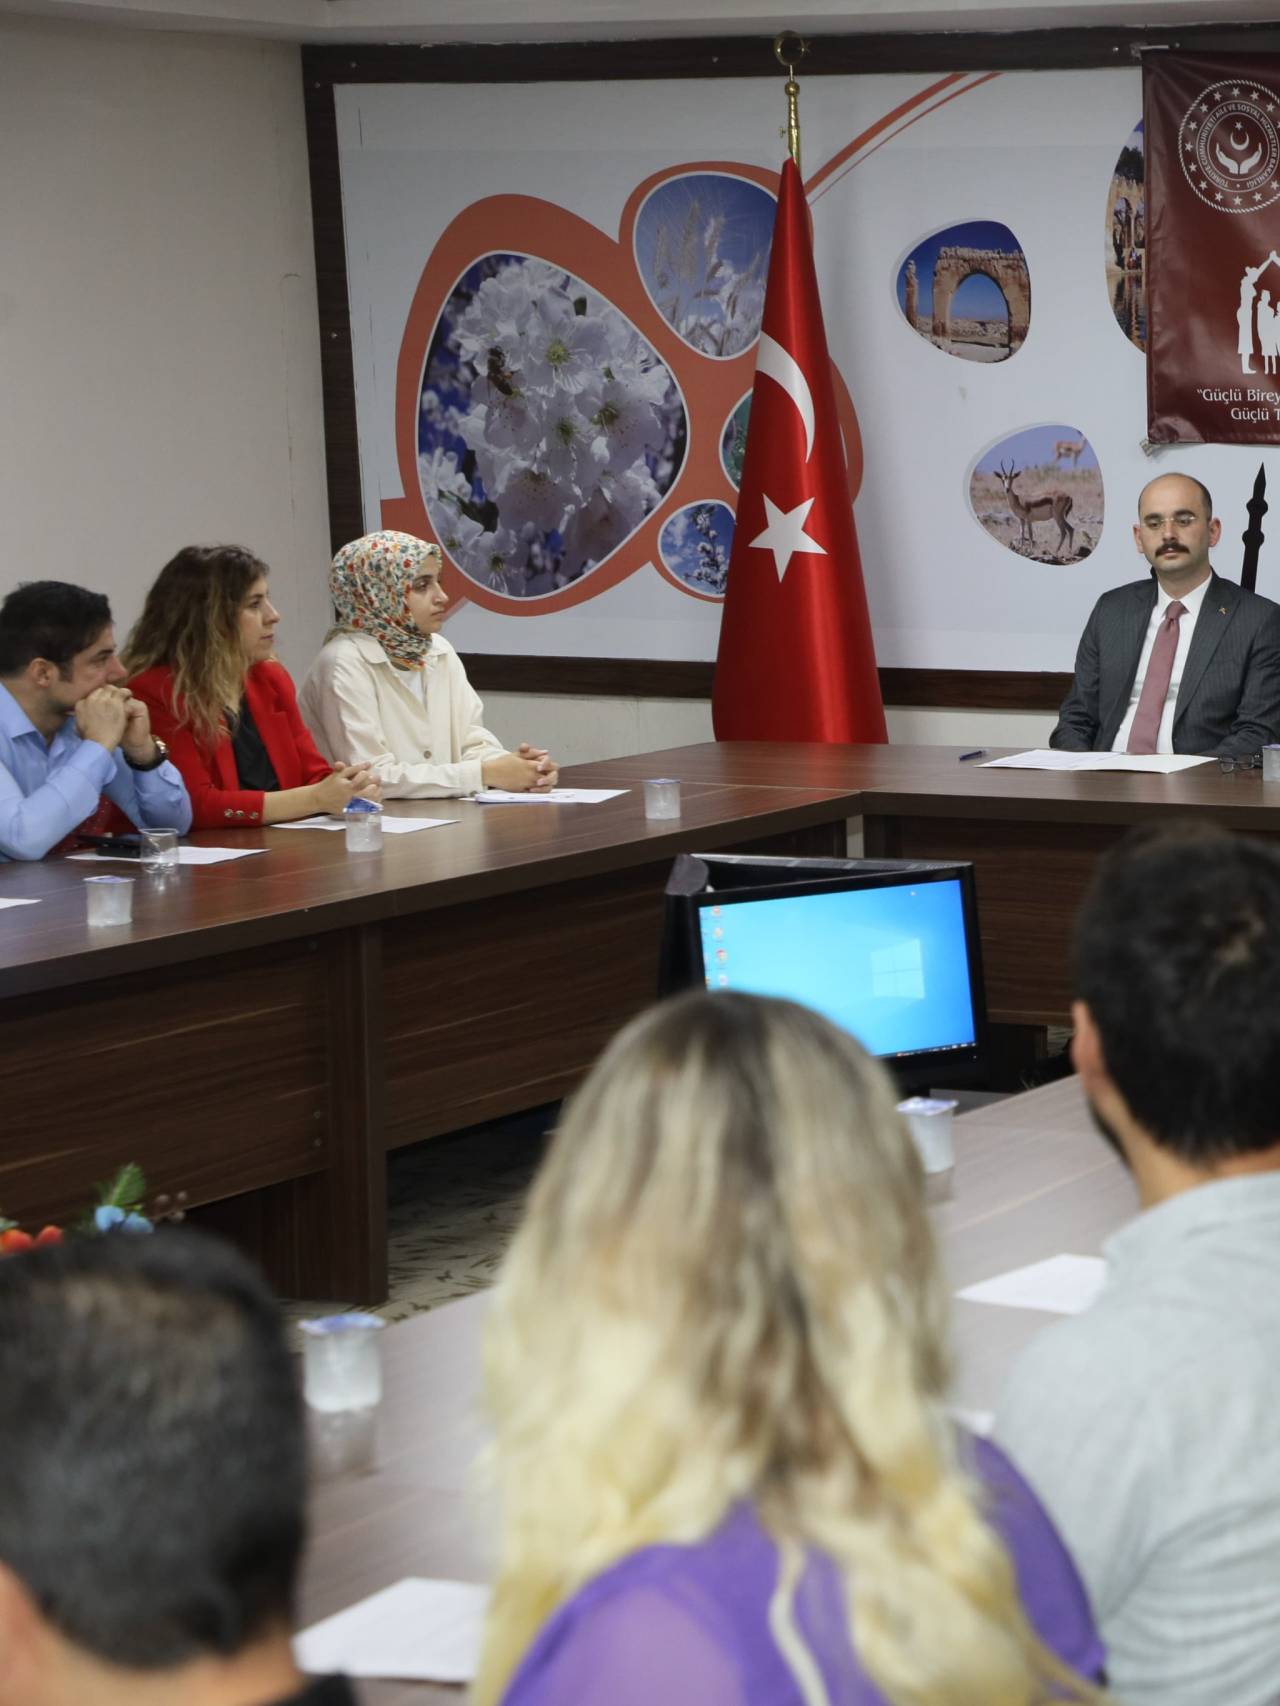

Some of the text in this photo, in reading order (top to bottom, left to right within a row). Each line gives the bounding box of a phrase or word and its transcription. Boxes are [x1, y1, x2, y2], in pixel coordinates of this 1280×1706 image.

[1226, 103, 1236, 111] VE
[1236, 103, 1262, 119] SOSYAL
[1230, 407, 1269, 423] Güçlü
